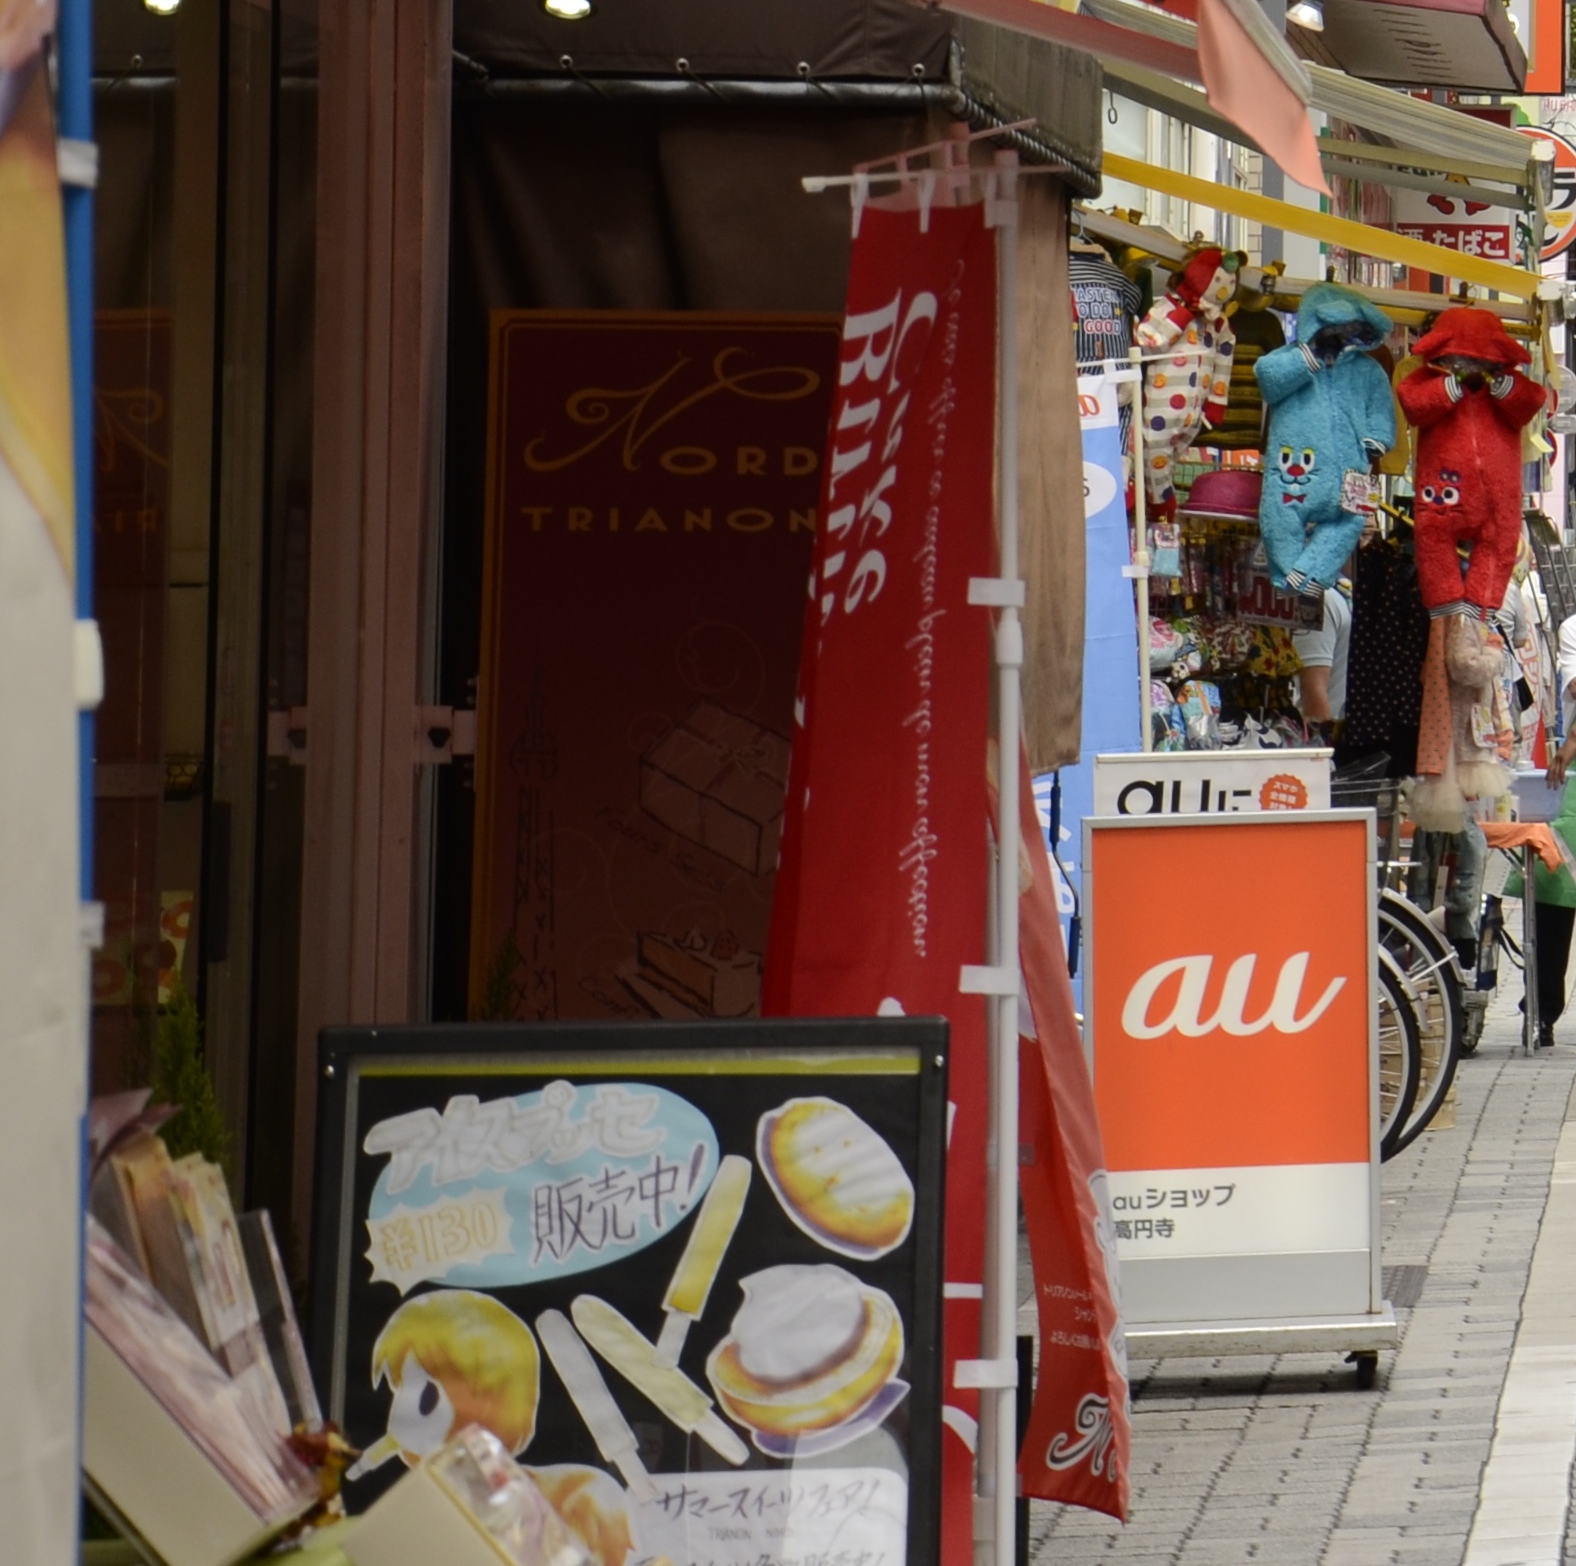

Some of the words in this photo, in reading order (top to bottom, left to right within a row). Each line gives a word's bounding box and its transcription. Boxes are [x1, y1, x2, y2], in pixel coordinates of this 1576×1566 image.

[1084, 319, 1121, 335] GOOD
[522, 507, 818, 532] TRIANON
[1122, 951, 1346, 1039] au
[533, 1142, 706, 1264] 販売中!
[1113, 1183, 1236, 1211] auショップ
[1113, 1218, 1175, 1240] 高円寺
